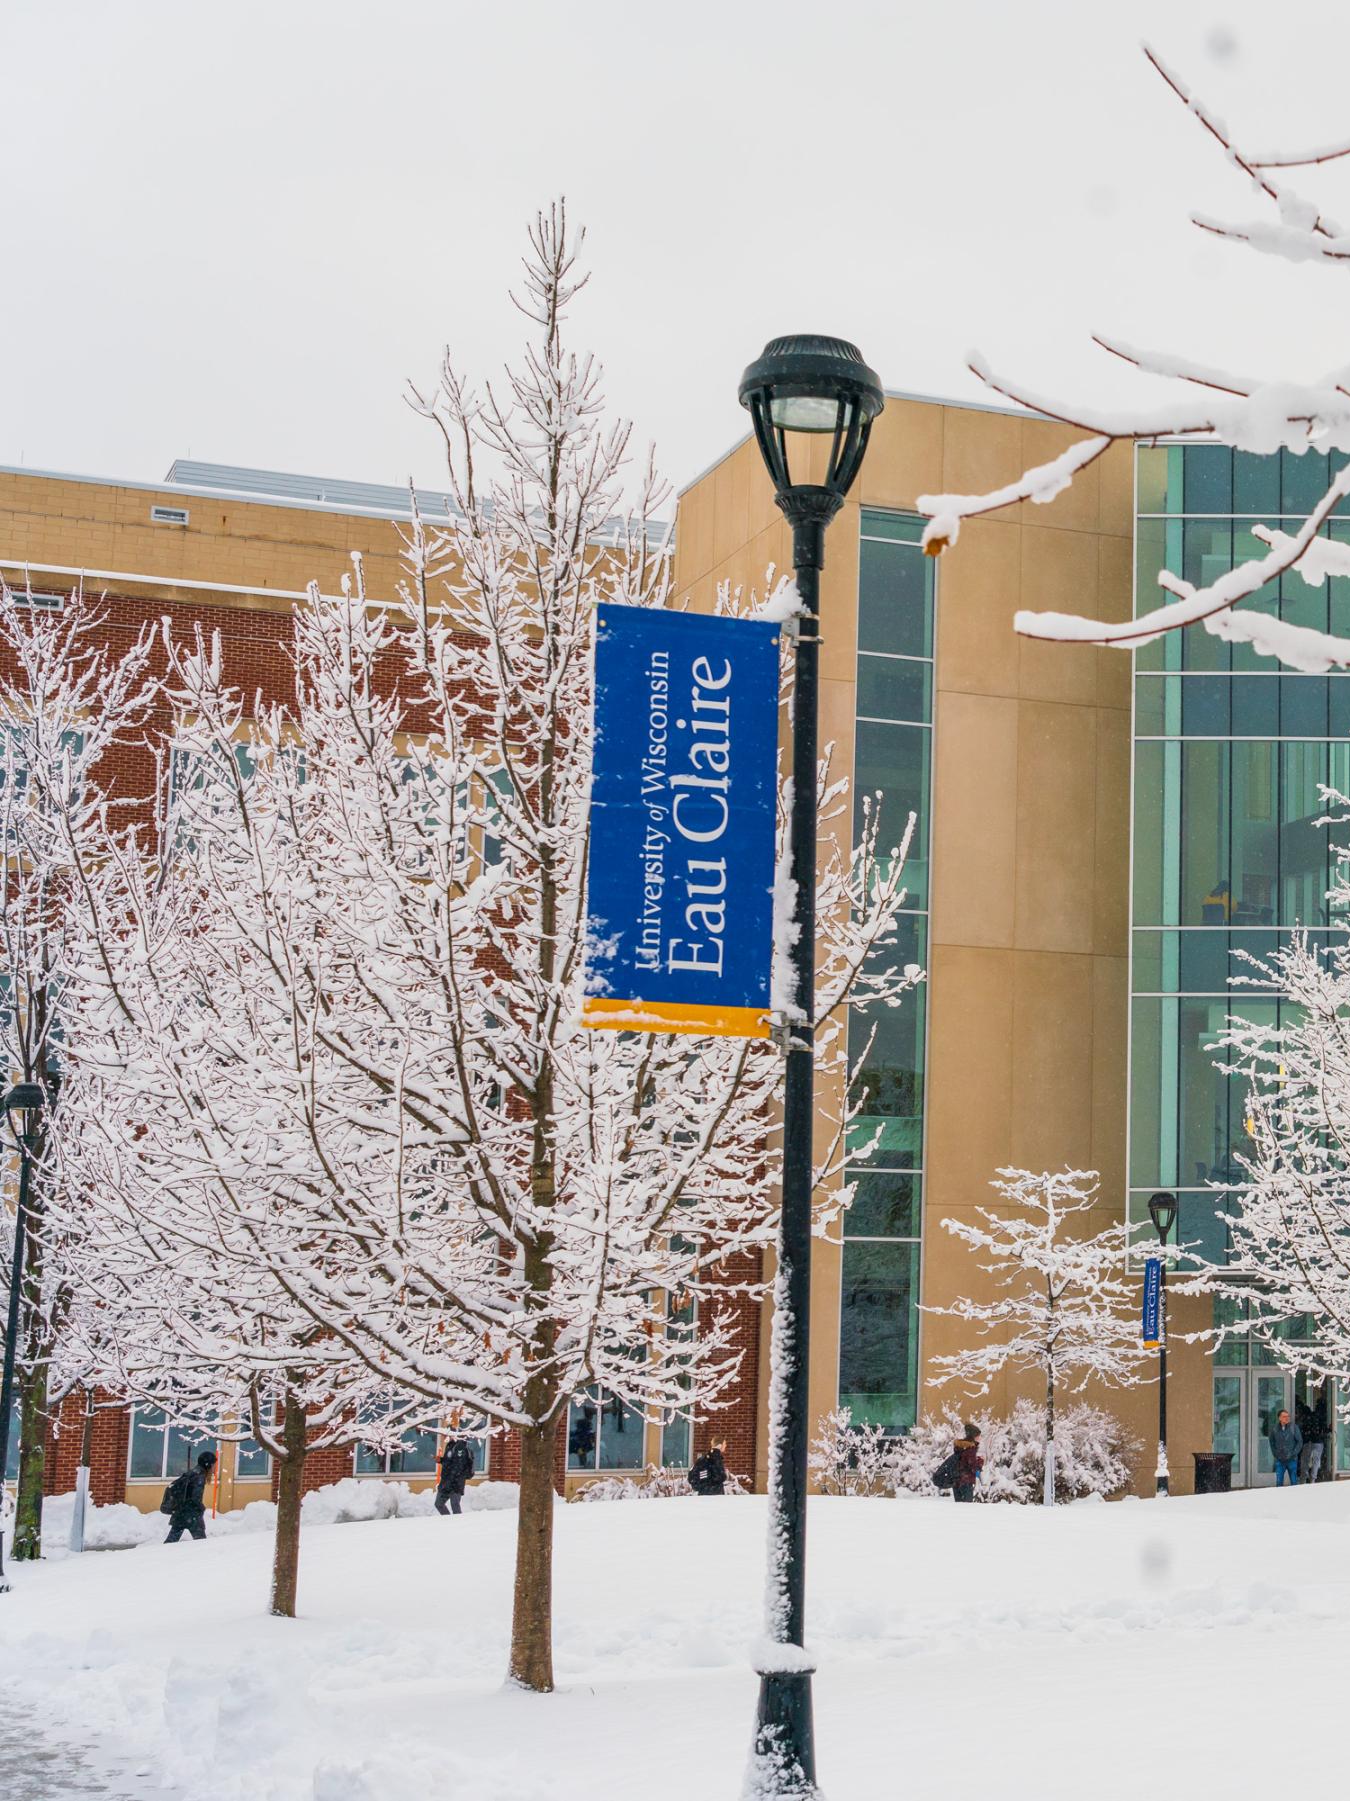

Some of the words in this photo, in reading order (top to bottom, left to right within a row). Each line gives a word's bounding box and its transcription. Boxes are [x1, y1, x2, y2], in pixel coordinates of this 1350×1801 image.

[641, 651, 670, 796] Wisconsin
[669, 655, 733, 843] Claire
[650, 799, 670, 822] of
[635, 826, 671, 972] University
[668, 857, 727, 978] Eau
[1149, 1266, 1157, 1308] Claire
